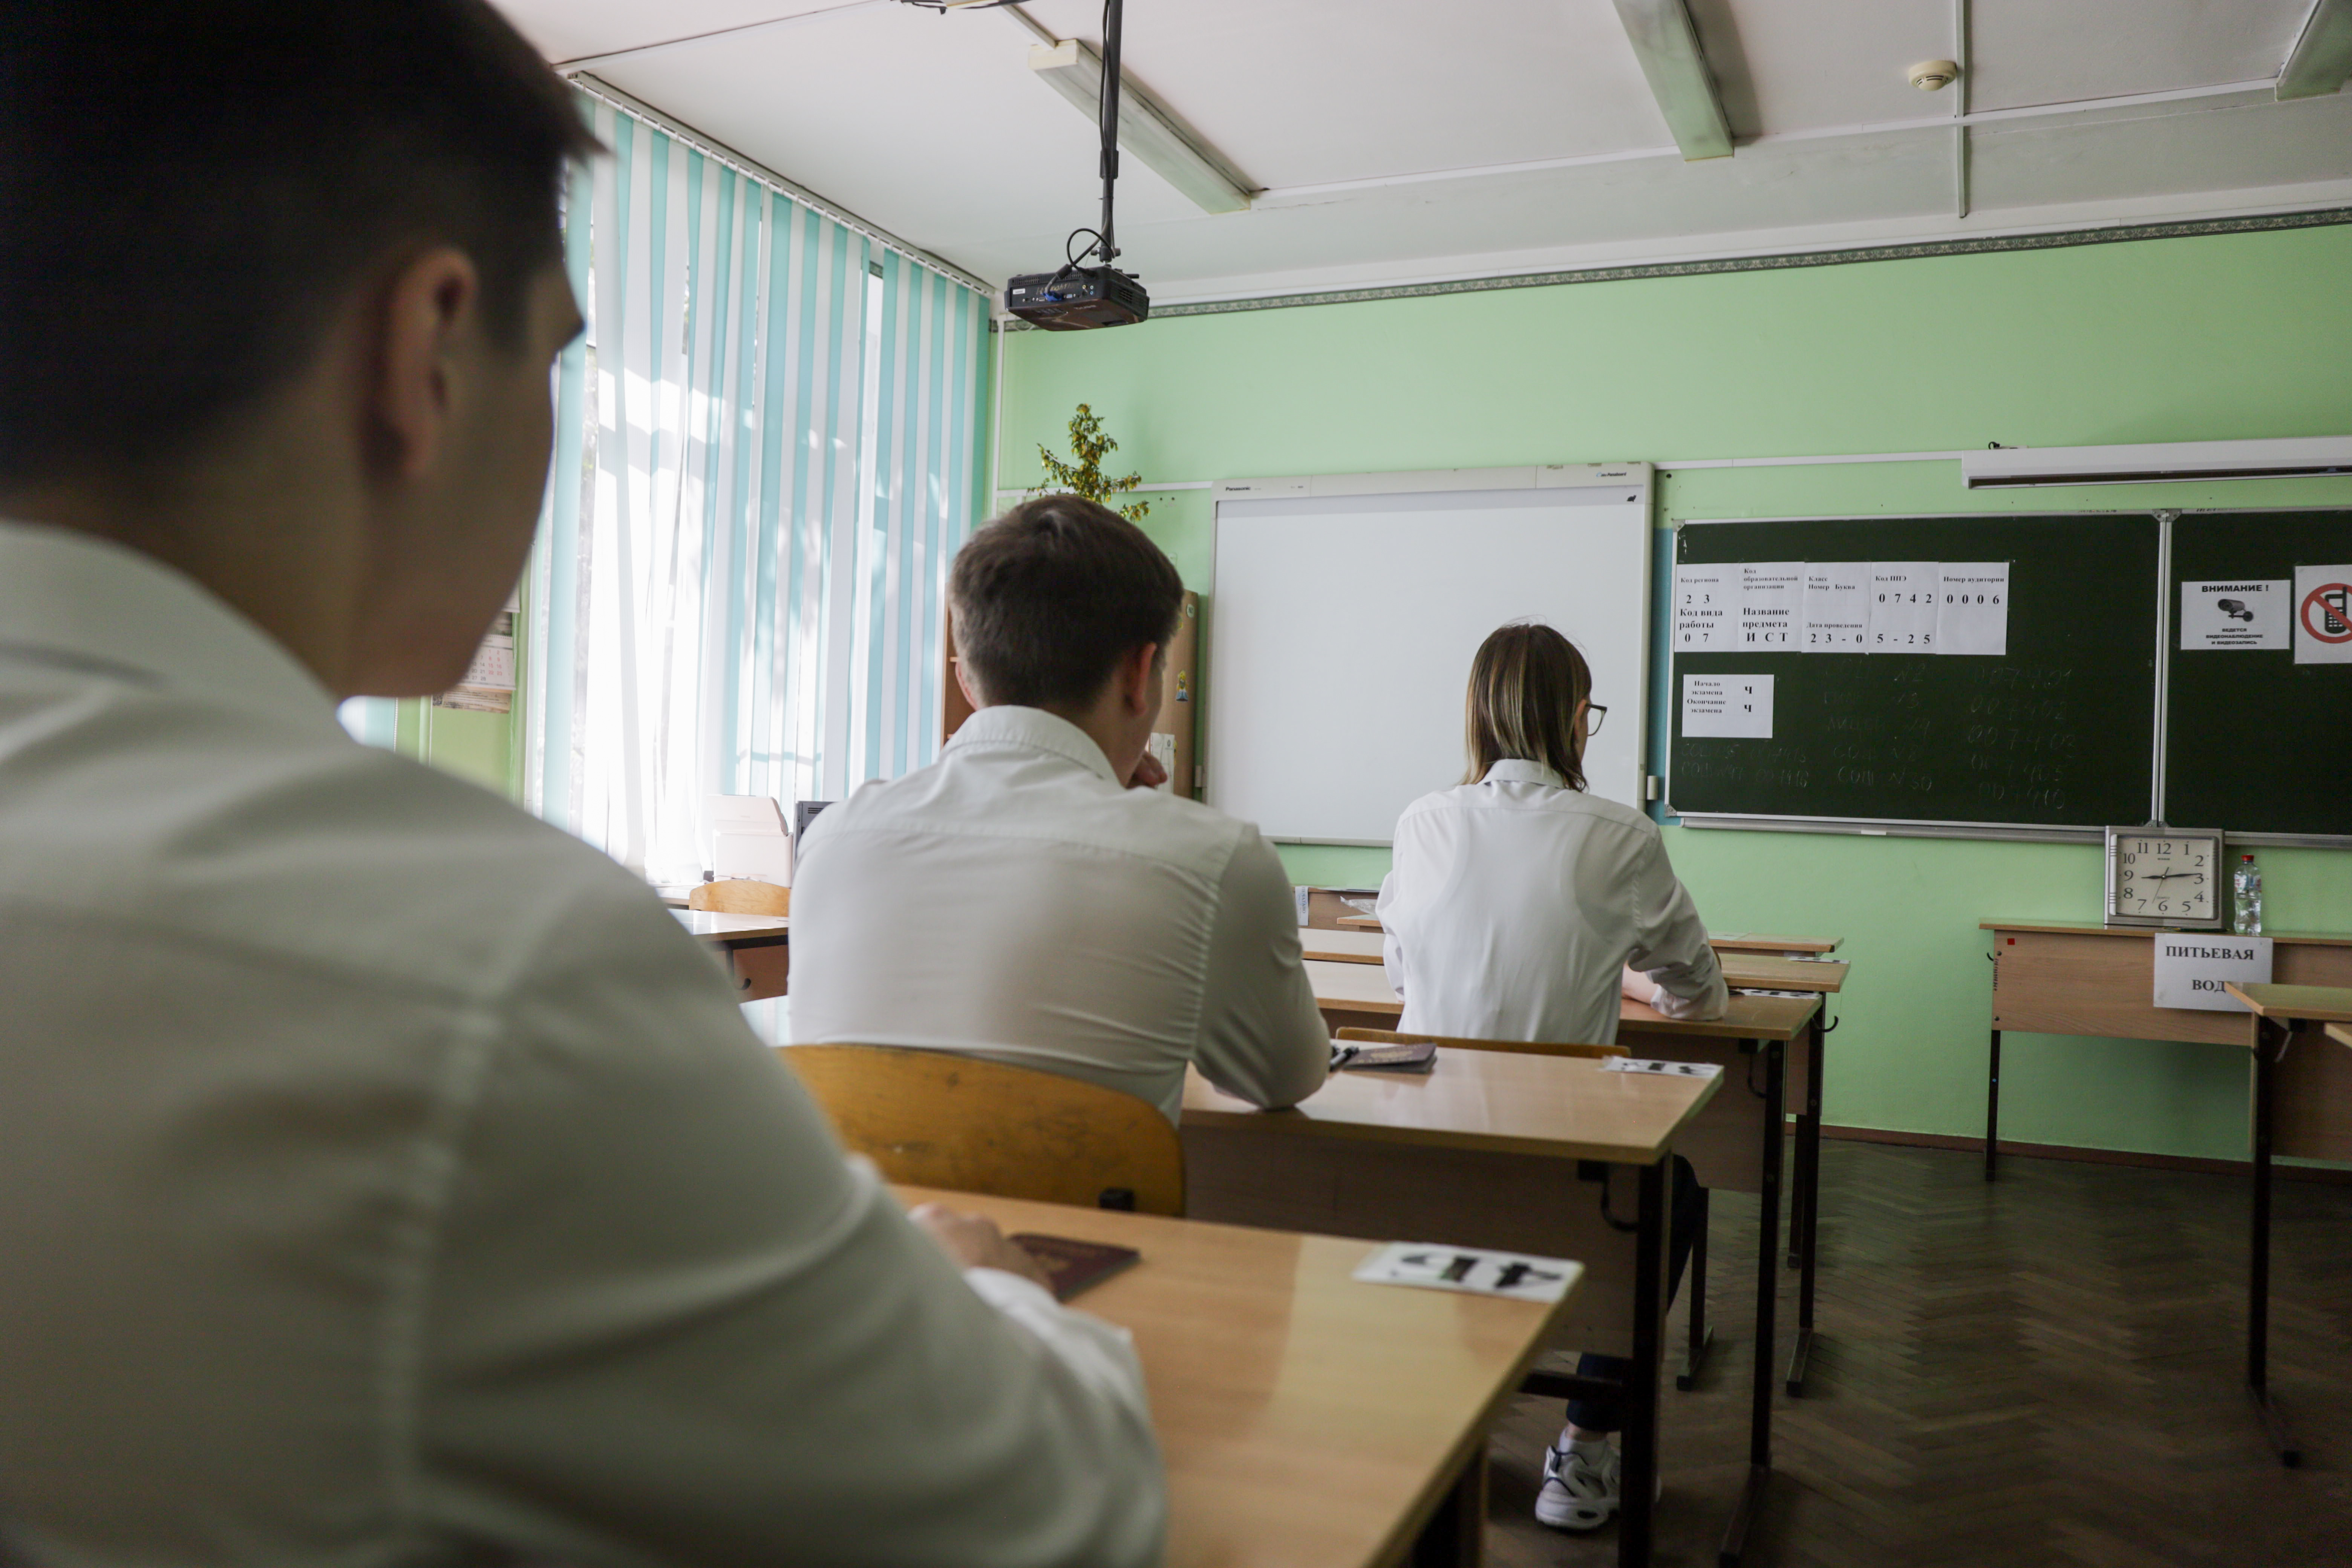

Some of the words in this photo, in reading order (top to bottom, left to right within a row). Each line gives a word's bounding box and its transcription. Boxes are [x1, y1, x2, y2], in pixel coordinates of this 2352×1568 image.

[1680, 621, 1714, 630] работы
[2137, 842, 2148, 854] 11
[2157, 843, 2171, 854] 12
[2184, 844, 2190, 855] 1
[2123, 853, 2136, 864] 10
[2194, 855, 2204, 867] 2
[2124, 870, 2134, 881] 9
[2194, 873, 2204, 884] 3
[2123, 887, 2133, 899] 8
[2194, 891, 2204, 902] 4
[2138, 899, 2147, 910] 7
[2158, 900, 2168, 911] 6
[2182, 901, 2191, 912] 5
[2166, 946, 2254, 960] ПИТЬЕВАЯ
[2192, 979, 2226, 993] ВОД
